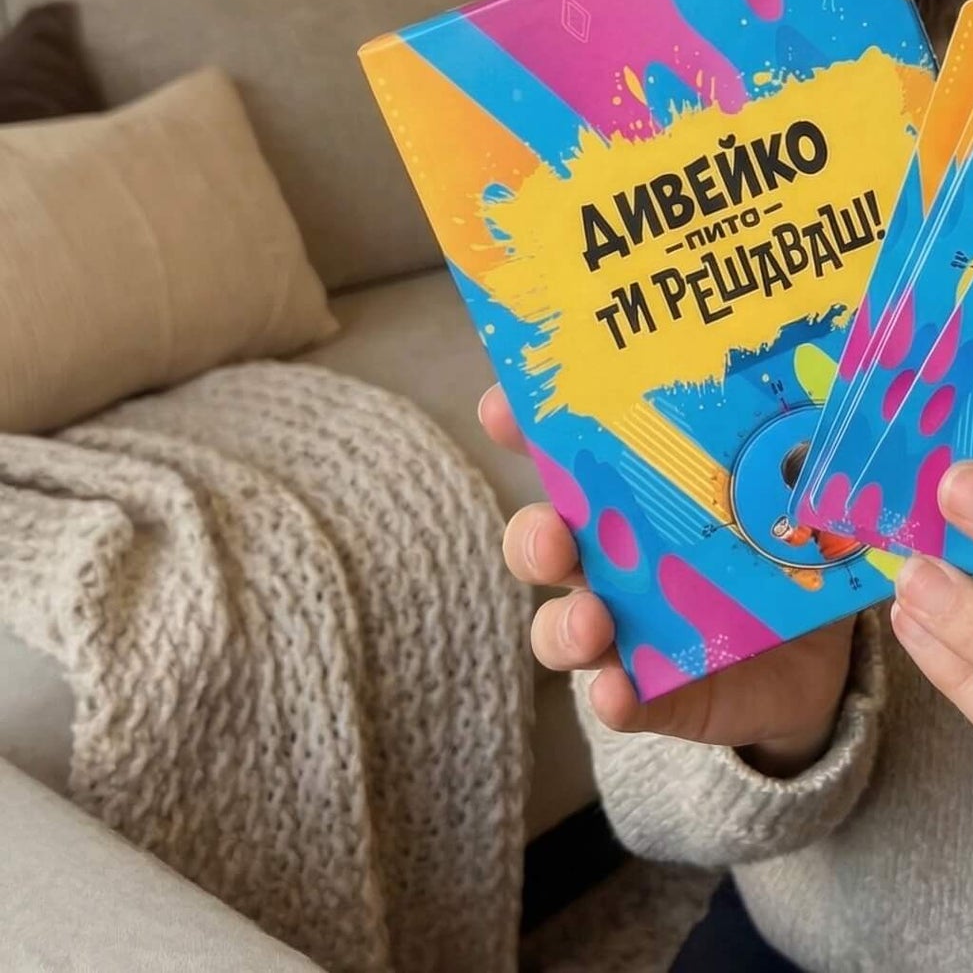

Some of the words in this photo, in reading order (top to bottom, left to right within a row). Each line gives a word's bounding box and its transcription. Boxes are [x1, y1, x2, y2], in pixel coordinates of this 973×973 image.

[581, 120, 828, 272] ДИВЕЙКО
[595, 282, 657, 350] ТИ
[650, 190, 886, 325] РЕШАВАШ!
